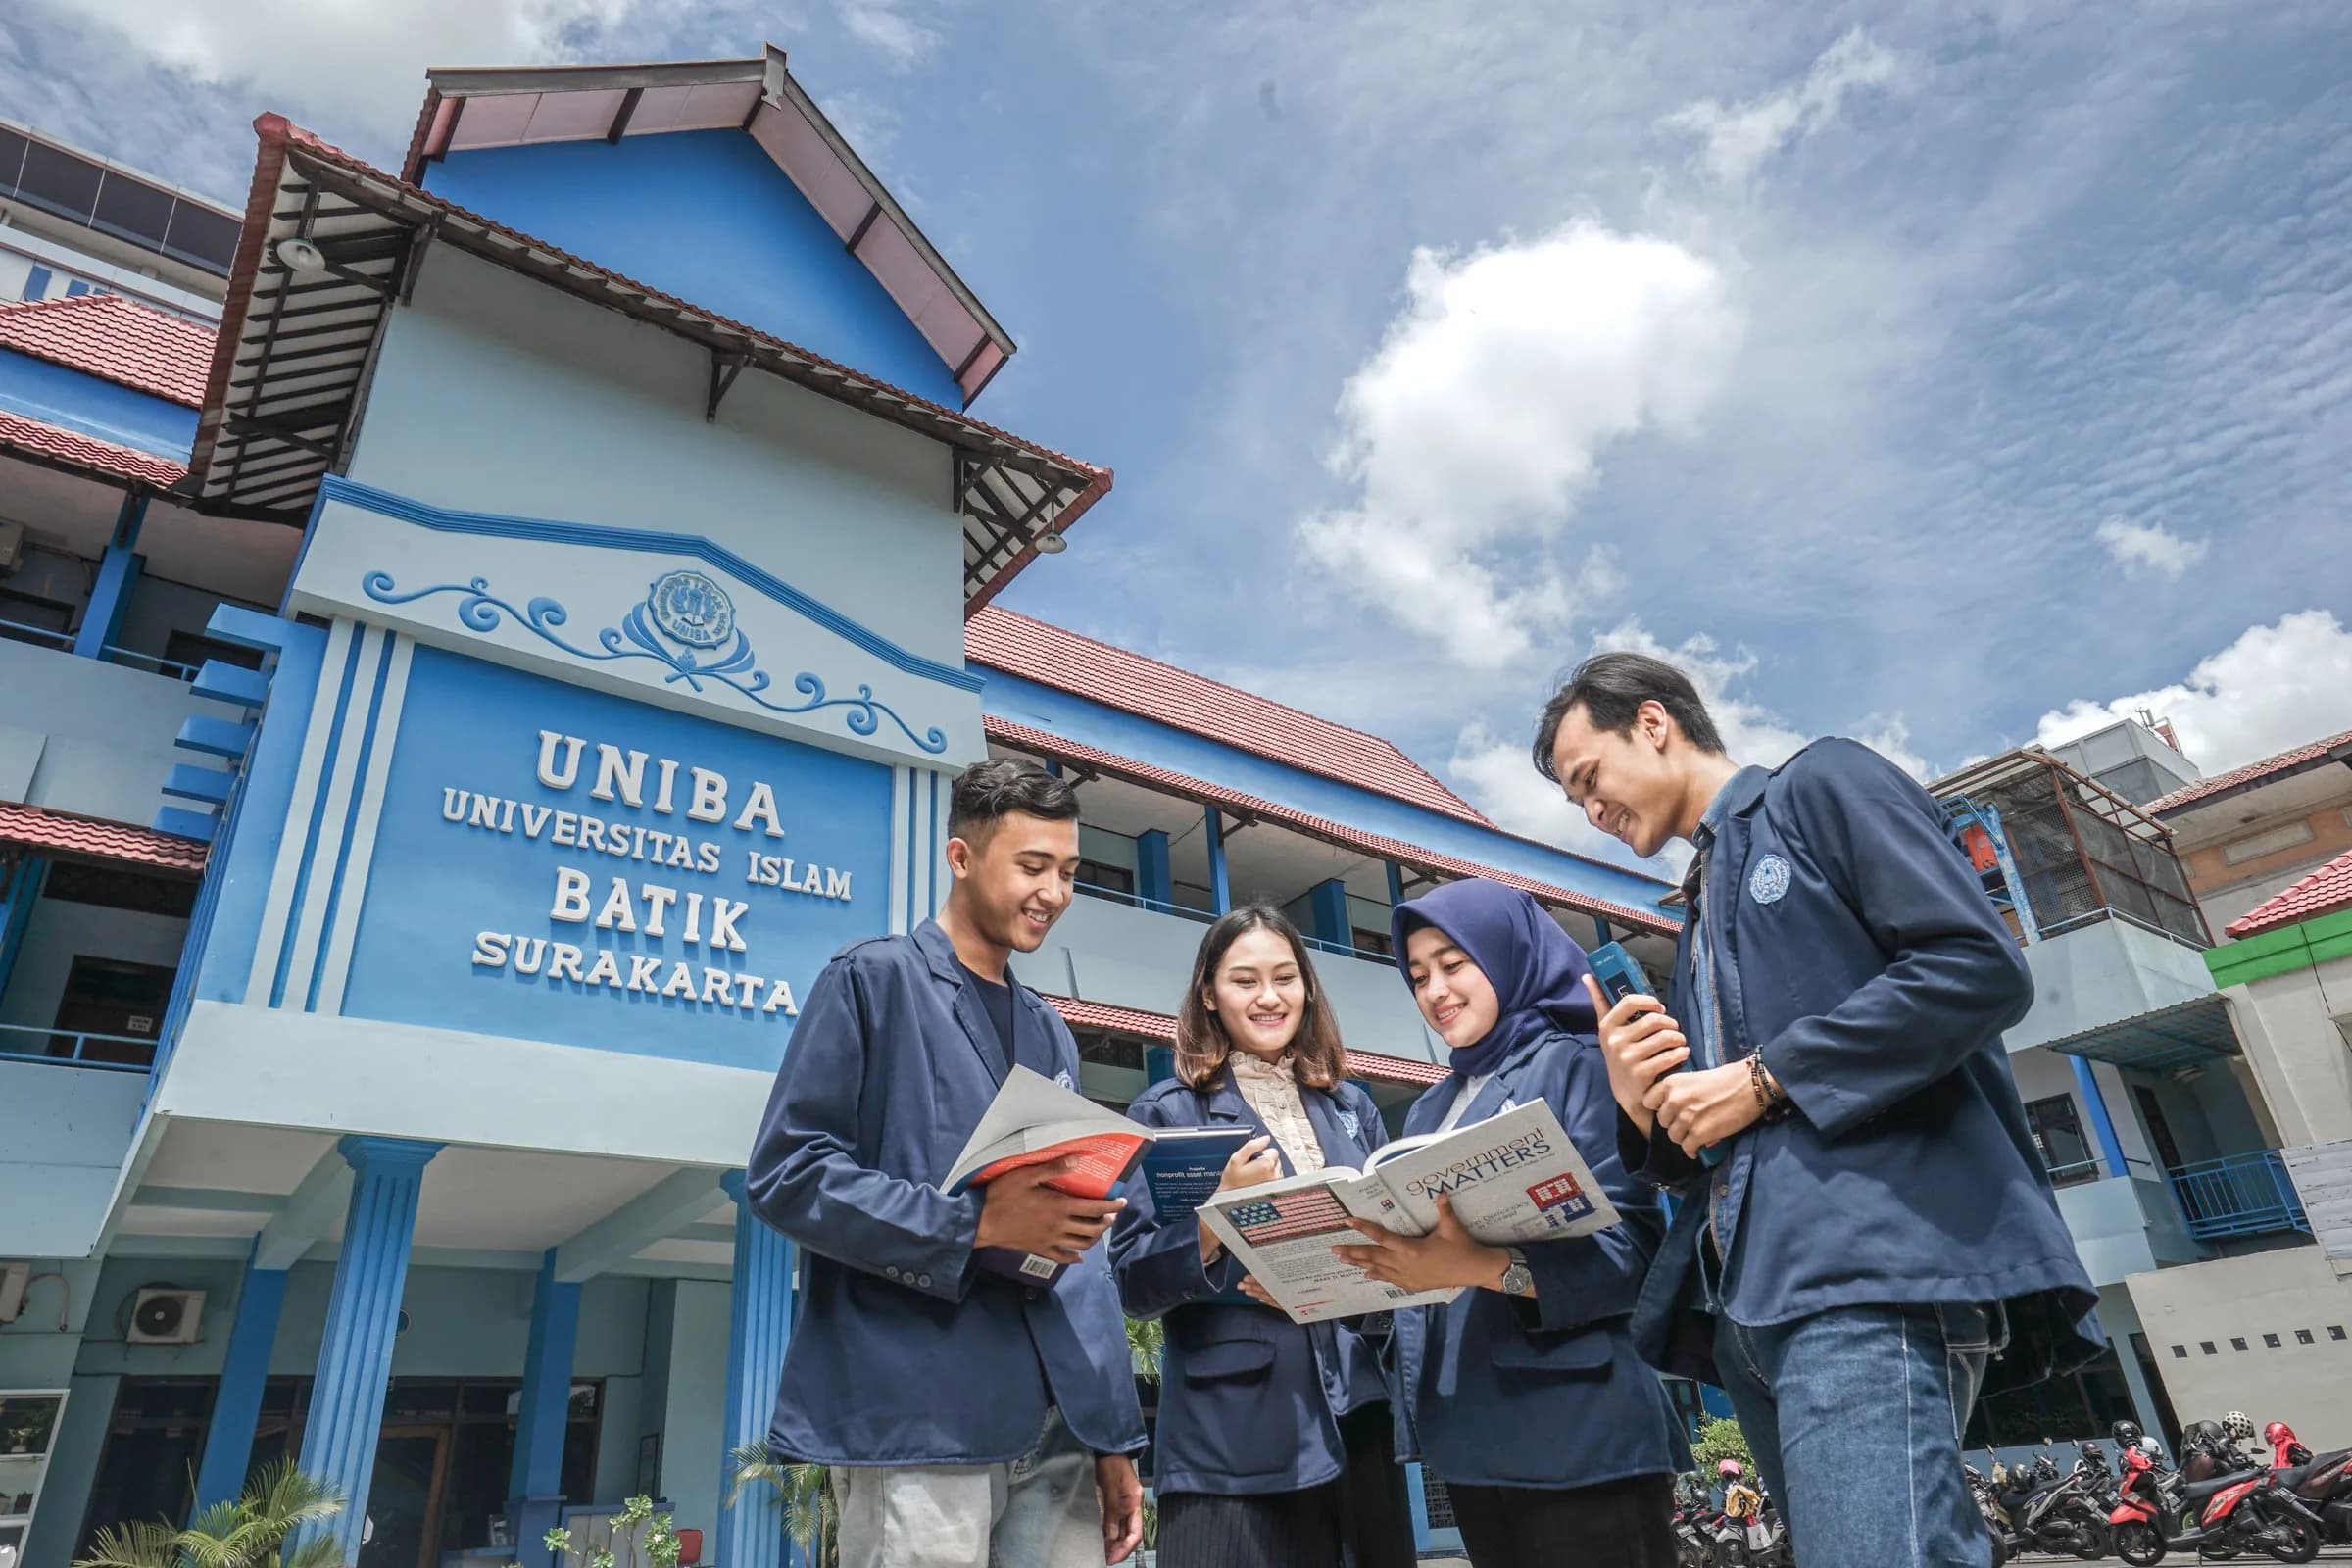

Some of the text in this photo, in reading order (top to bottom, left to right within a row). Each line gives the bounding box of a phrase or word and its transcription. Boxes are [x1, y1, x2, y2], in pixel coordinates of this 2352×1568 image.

[537, 729, 785, 838] UNIBA
[443, 787, 852, 901] UNIVERSITAS ISLAM
[549, 866, 749, 952] BATIK
[472, 931, 799, 1016] SURAKARTA
[1405, 1127, 1544, 1197] government
[1426, 1139, 1551, 1200] MATTERS
